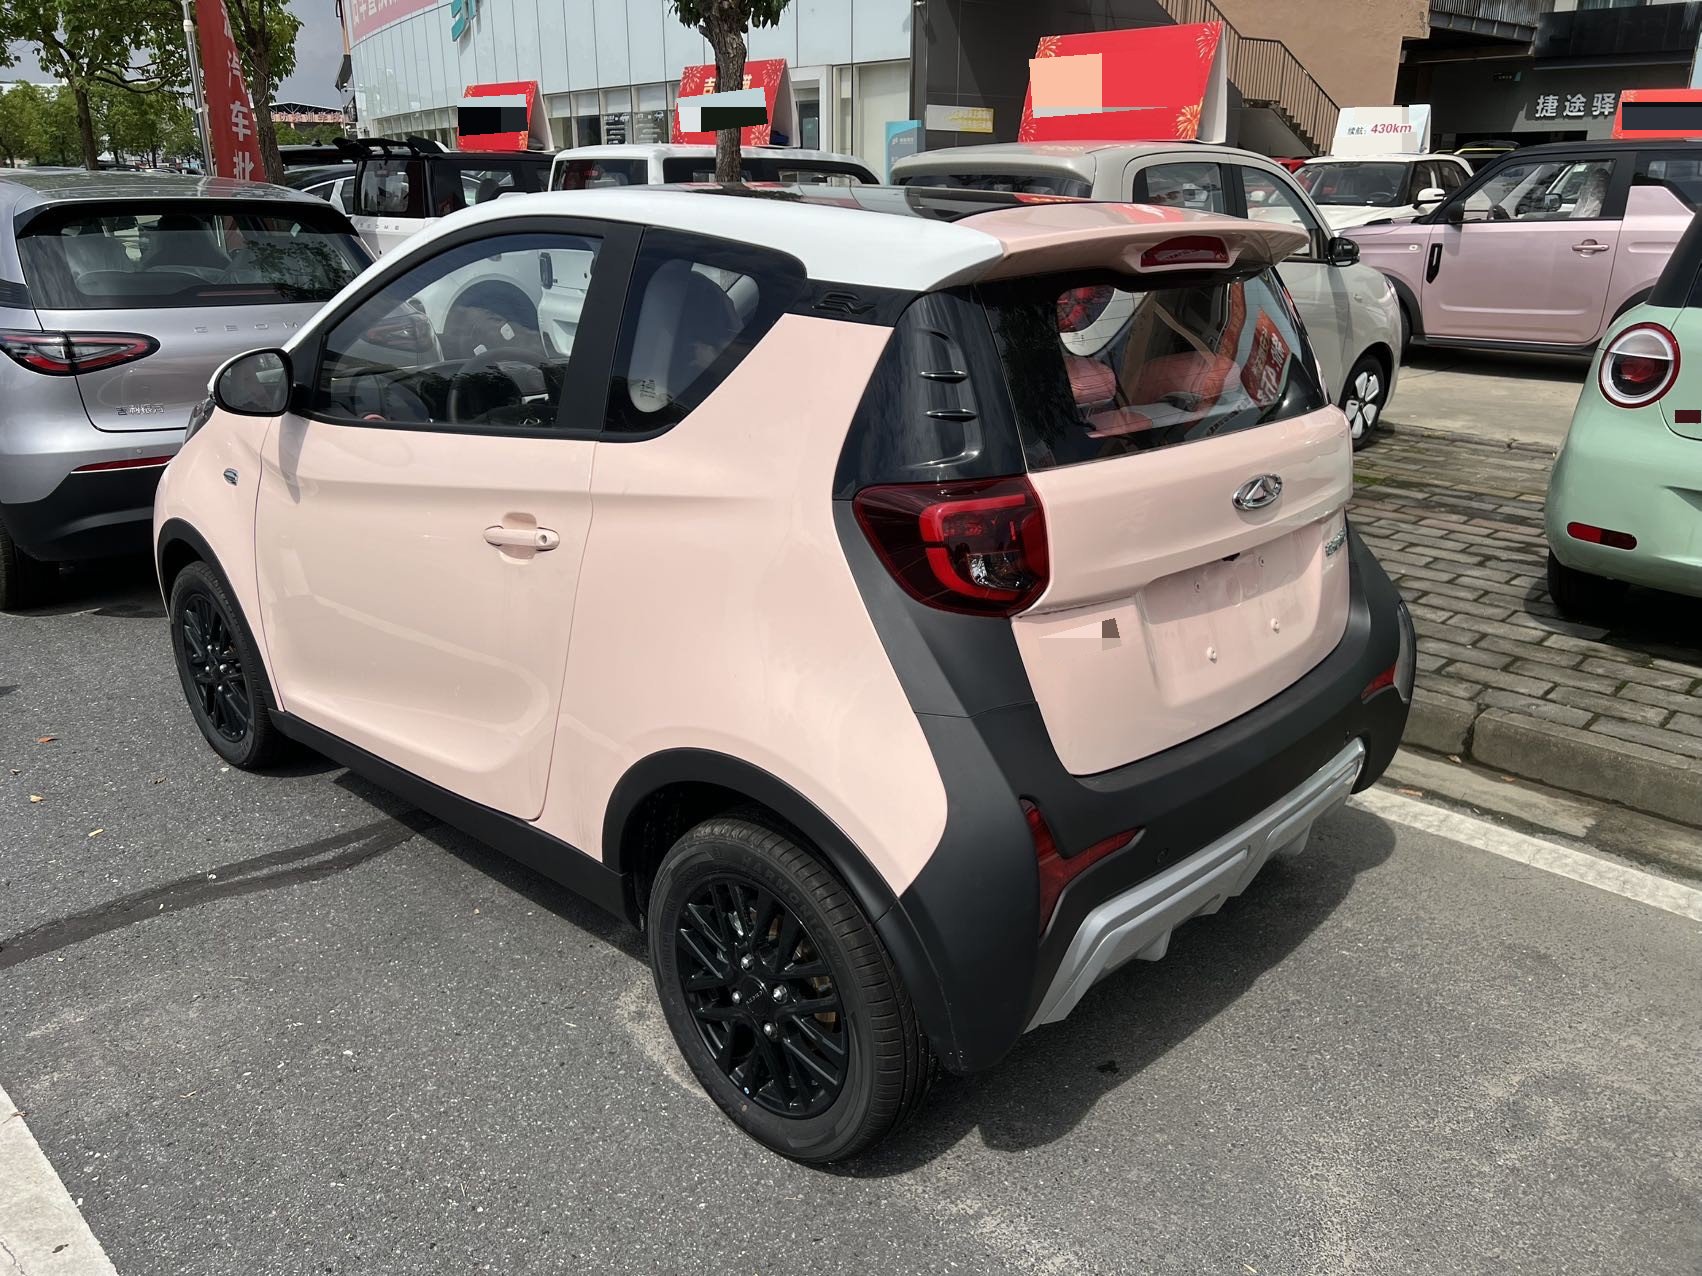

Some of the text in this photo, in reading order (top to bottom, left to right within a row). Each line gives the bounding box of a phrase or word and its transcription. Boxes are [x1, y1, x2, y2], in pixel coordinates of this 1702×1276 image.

[1535, 93, 1616, 117] 捷途驿
[1371, 123, 1412, 134] 430km
